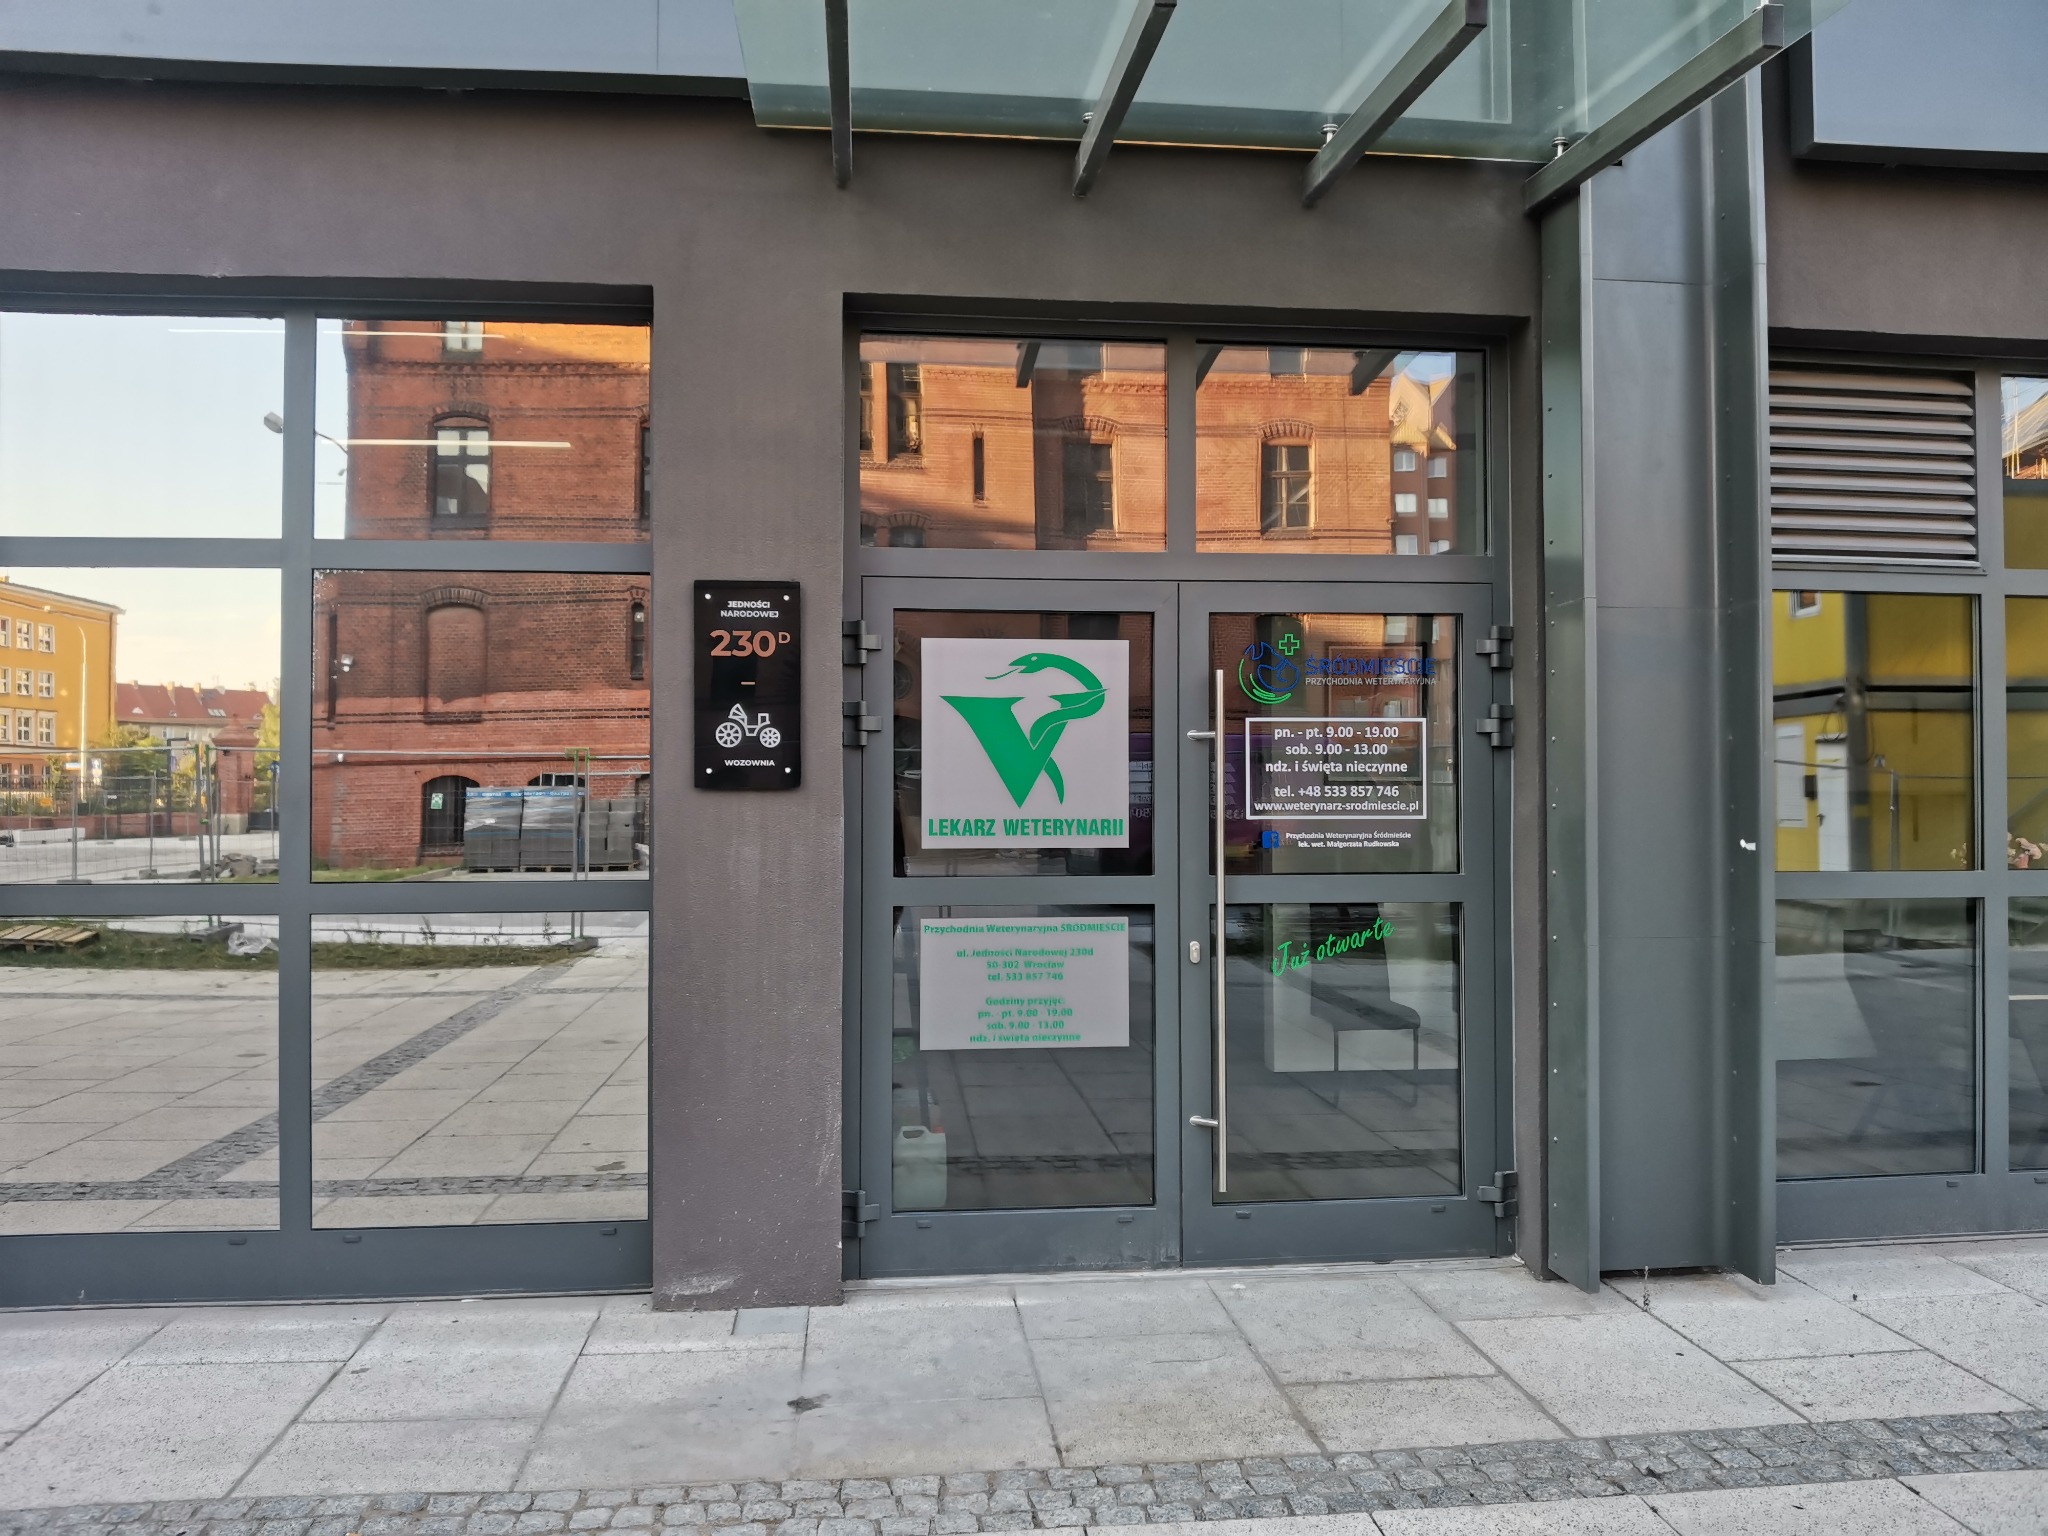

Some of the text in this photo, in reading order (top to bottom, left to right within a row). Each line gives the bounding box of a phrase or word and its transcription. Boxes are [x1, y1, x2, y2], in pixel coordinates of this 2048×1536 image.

[727, 600, 771, 608] JEDNOŚCI
[720, 610, 779, 618] NARODOWEJ
[1305, 652, 1436, 675] ŚRÓDMIEŚCIE
[1305, 677, 1437, 686] PRZYCHODNIA WETERYNARYJNA
[1274, 728, 1295, 740] pn.
[1305, 727, 1323, 740] pt.
[1326, 726, 1354, 738] 9.00
[1364, 726, 1399, 738] 19.00
[1285, 743, 1312, 755] sob.
[1315, 743, 1343, 755] 9.00
[1353, 743, 1388, 755] 13.00
[724, 759, 775, 767] WOZOWNIA
[1265, 760, 1408, 775] ndz. i święta nieczynne
[1274, 785, 1400, 797] tel. +48 533 857 746
[1254, 800, 1419, 812] www.weterynarz-srodmiescie.pl
[928, 818, 1124, 837] LEKARZ WETERYNARII
[1285, 831, 1325, 840] Przychodnia
[1325, 831, 1373, 840] Weterynaryjna
[924, 925, 985, 935] Przychodnia
[986, 924, 1058, 935] Weterynaryjna
[1271, 916, 1397, 977] Już otwarte
[956, 948, 969, 958] ul.
[1015, 948, 1068, 958] Narodowej
[1070, 947, 1094, 957] 230d
[987, 972, 1064, 981] tel. 533 857 746
[985, 997, 1025, 1007] Godziny
[1001, 1010, 1014, 1019] pt.
[1017, 1009, 1038, 1017] 9.00
[1047, 1008, 1073, 1017] 19.00
[987, 1021, 1007, 1030] sob.
[1009, 1021, 1030, 1030] 9.00
[1038, 1020, 1064, 1030] 13.00
